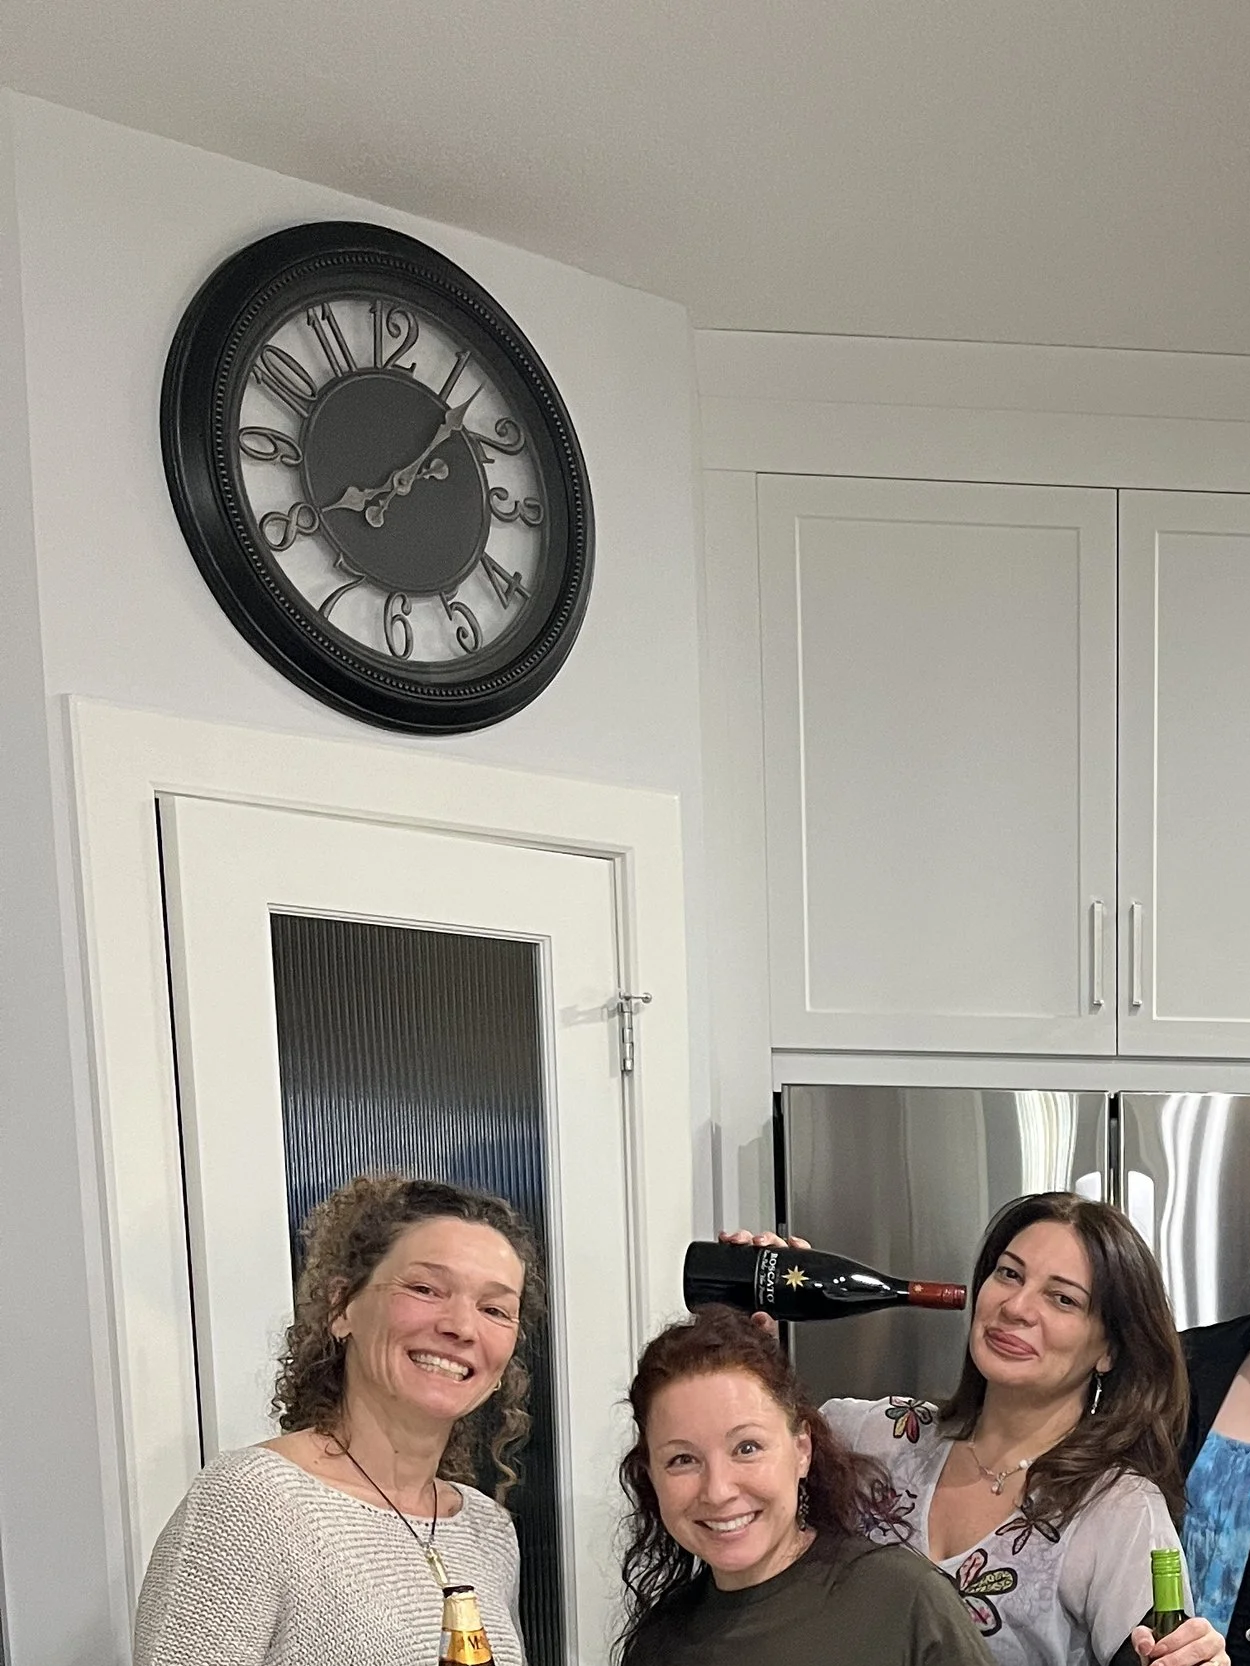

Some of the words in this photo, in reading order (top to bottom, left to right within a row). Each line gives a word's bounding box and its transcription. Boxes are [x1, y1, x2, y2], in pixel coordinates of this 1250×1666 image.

[306, 302, 358, 377] 11
[371, 301, 419, 377] 12
[251, 345, 318, 419] 10
[437, 350, 472, 407] 1
[238, 425, 303, 467] 9
[469, 417, 525, 464] 2
[259, 501, 320, 552] 8
[488, 487, 544, 527] 3
[318, 553, 367, 619] 7
[480, 551, 531, 610] 4
[383, 592, 414, 661] 6
[439, 586, 484, 653] 5
[766, 1252, 779, 1304] ROSCATO
